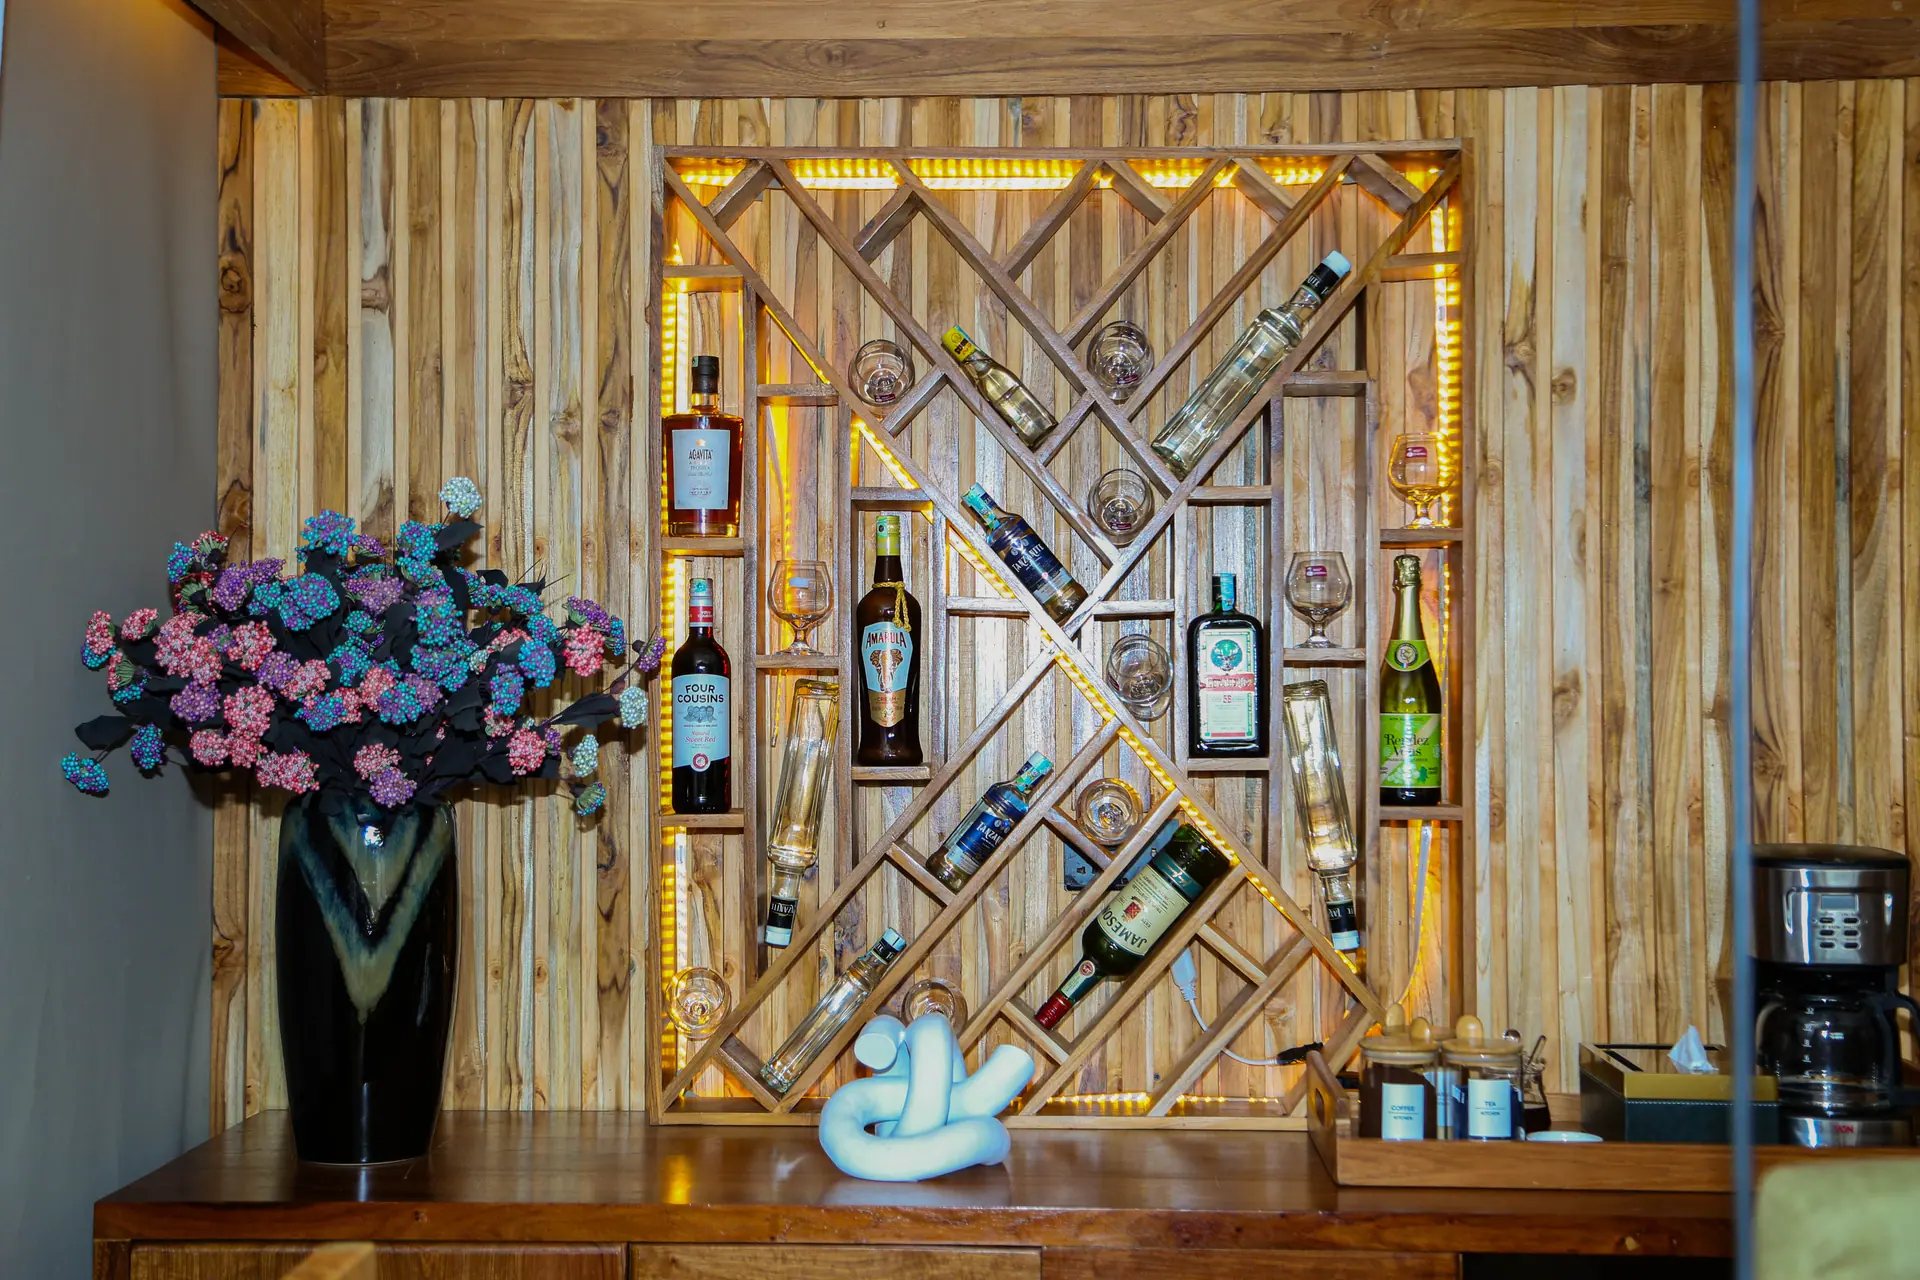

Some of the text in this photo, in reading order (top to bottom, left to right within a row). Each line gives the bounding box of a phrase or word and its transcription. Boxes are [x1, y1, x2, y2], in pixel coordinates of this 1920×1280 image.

[688, 448, 712, 460] AGAVITA
[686, 684, 716, 694] FOUR
[677, 694, 724, 703] COUSINS
